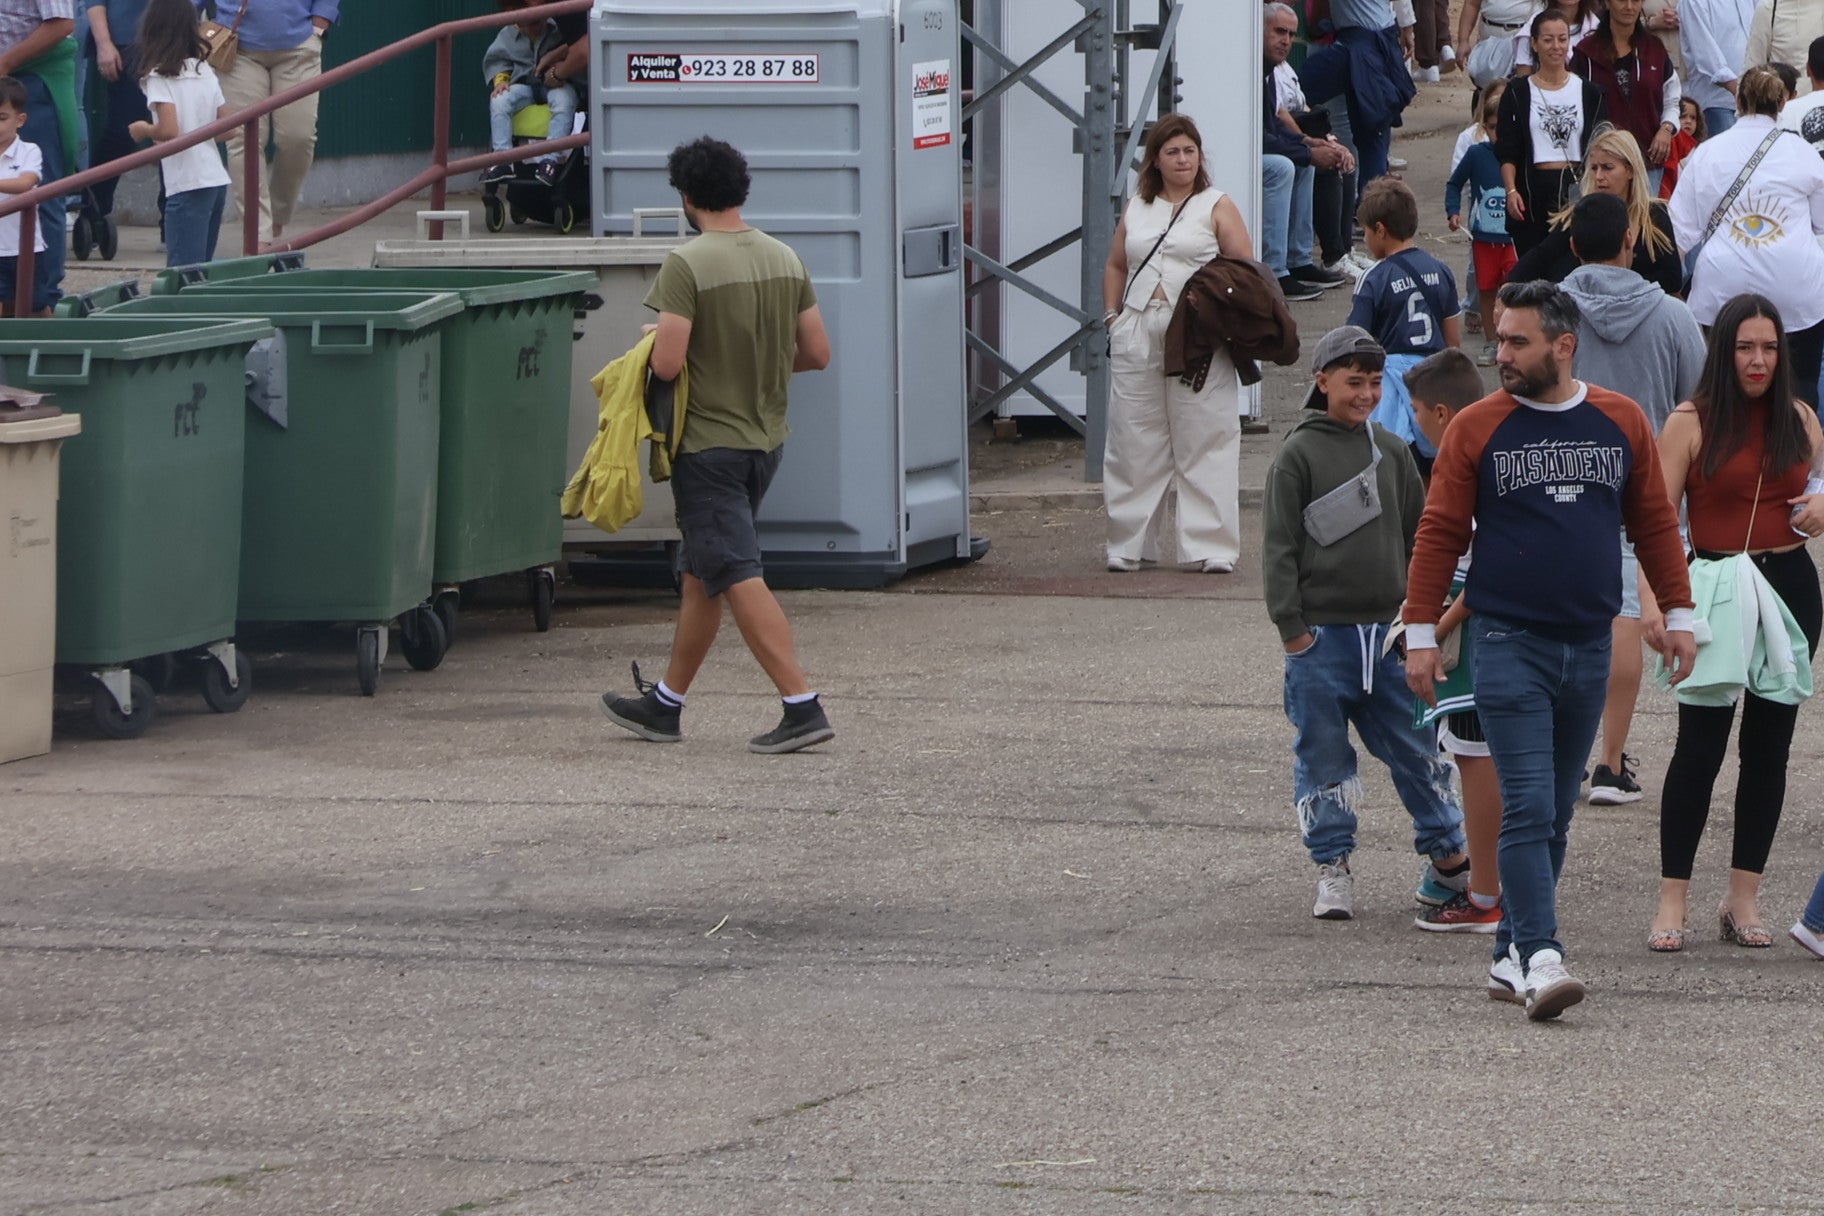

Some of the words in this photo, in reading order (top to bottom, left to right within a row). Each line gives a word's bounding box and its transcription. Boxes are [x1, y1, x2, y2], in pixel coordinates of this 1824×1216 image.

[631, 56, 677, 69] Alquiler
[692, 59, 727, 77] 923
[733, 59, 756, 77] 28
[762, 59, 785, 77] 87
[791, 59, 815, 77] 88
[630, 70, 638, 80] y
[642, 68, 676, 79] Venta
[1728, 179, 1744, 200] TOUS
[1746, 149, 1764, 171] TOUS
[1407, 291, 1433, 347] 5
[1523, 439, 1598, 449] california
[1493, 447, 1624, 497] PASADENA
[1545, 485, 1557, 495] LOS
[1558, 484, 1585, 495] ANGELES
[1554, 493, 1577, 503] COUNTY
